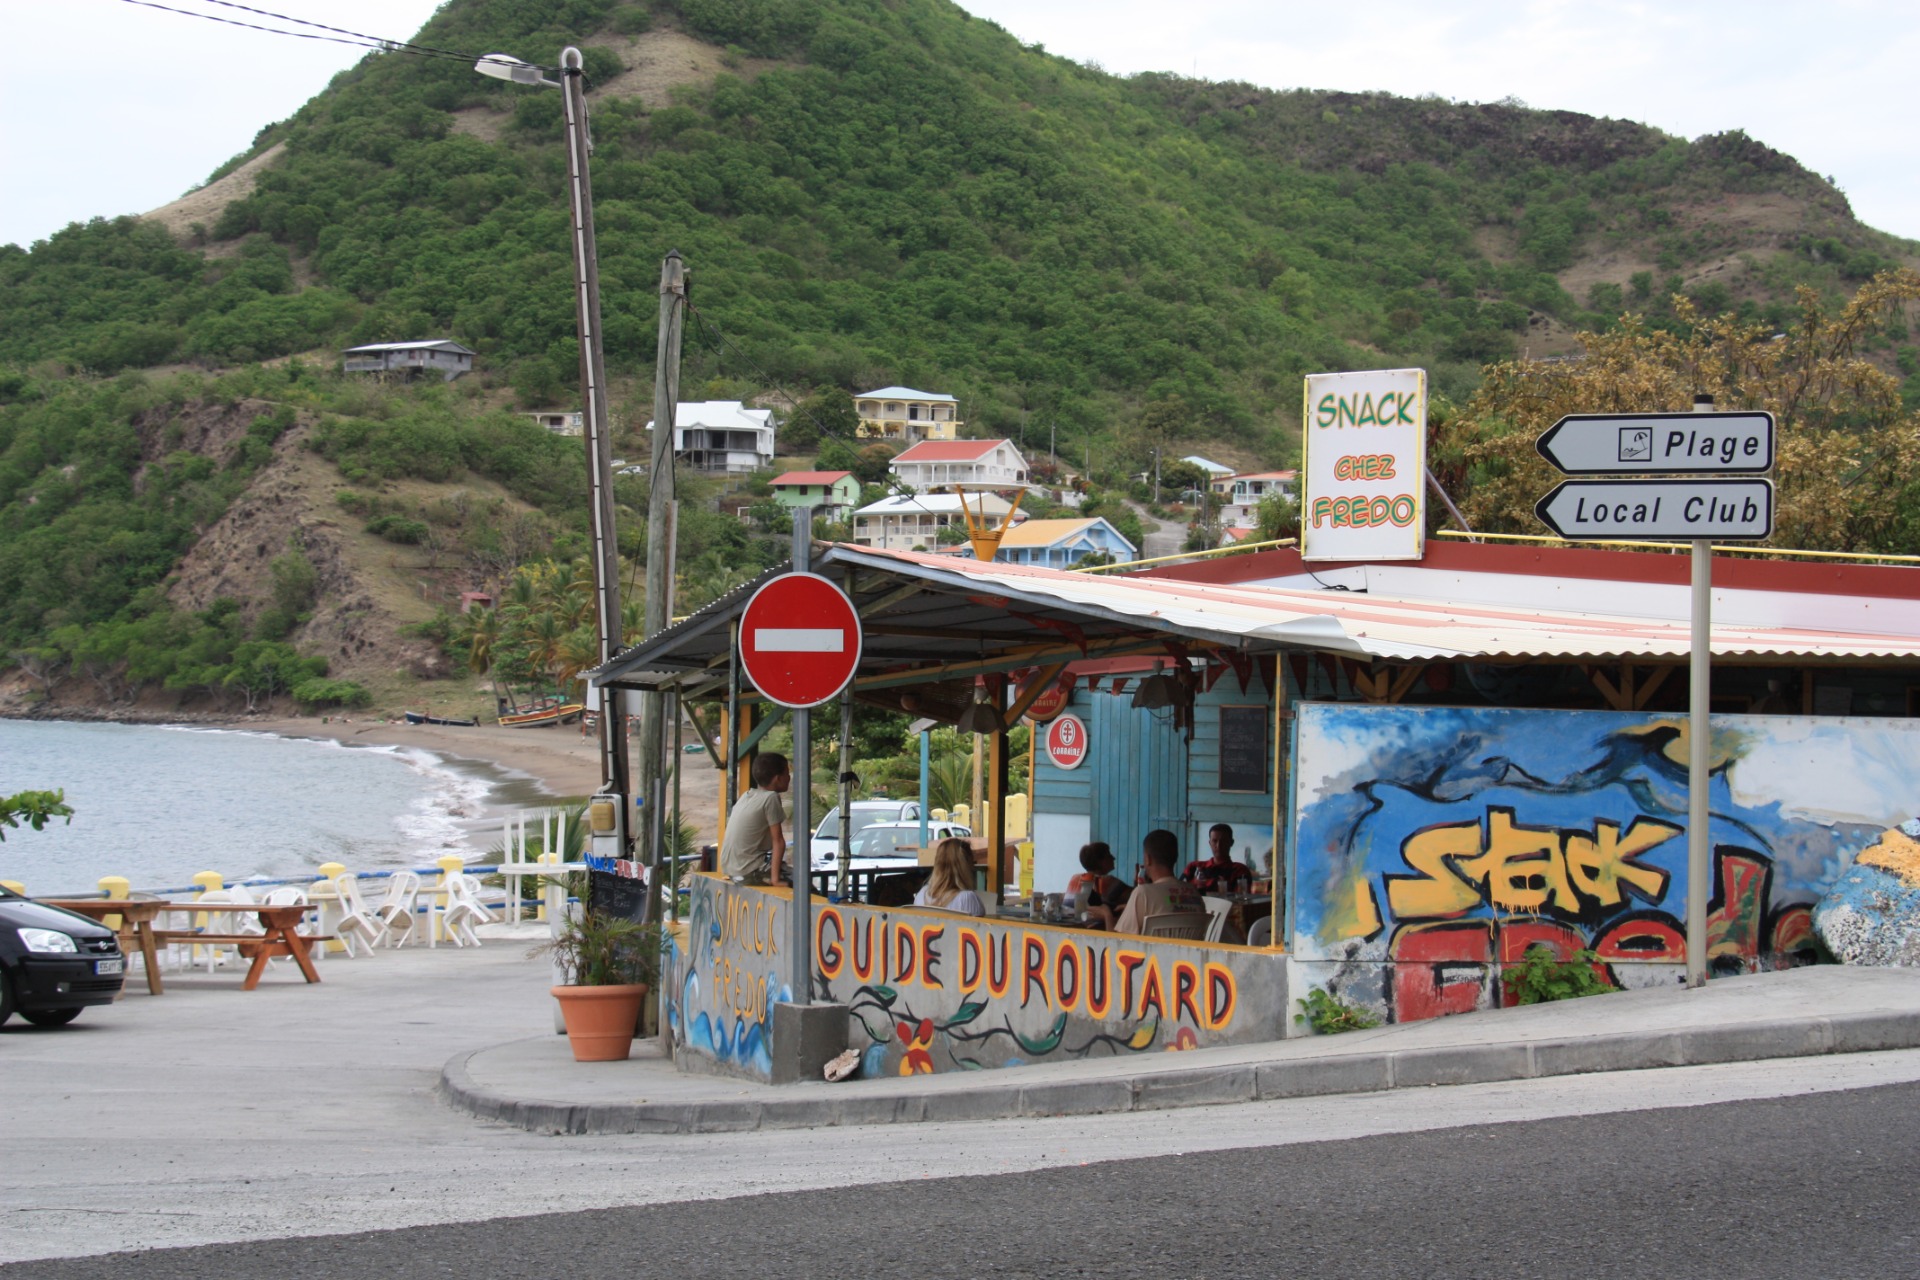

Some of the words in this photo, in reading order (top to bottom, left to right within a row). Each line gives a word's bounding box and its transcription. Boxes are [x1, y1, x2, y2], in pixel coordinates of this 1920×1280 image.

[1317, 392, 1416, 429] SNACK
[1665, 430, 1759, 464] Plage
[1334, 454, 1396, 481] CHEZ
[1312, 494, 1415, 528] FREDO
[1575, 497, 1661, 523] Local
[1684, 496, 1758, 523] Club
[958, 927, 1011, 999] DU
[1020, 930, 1237, 1032] ROUTARD
